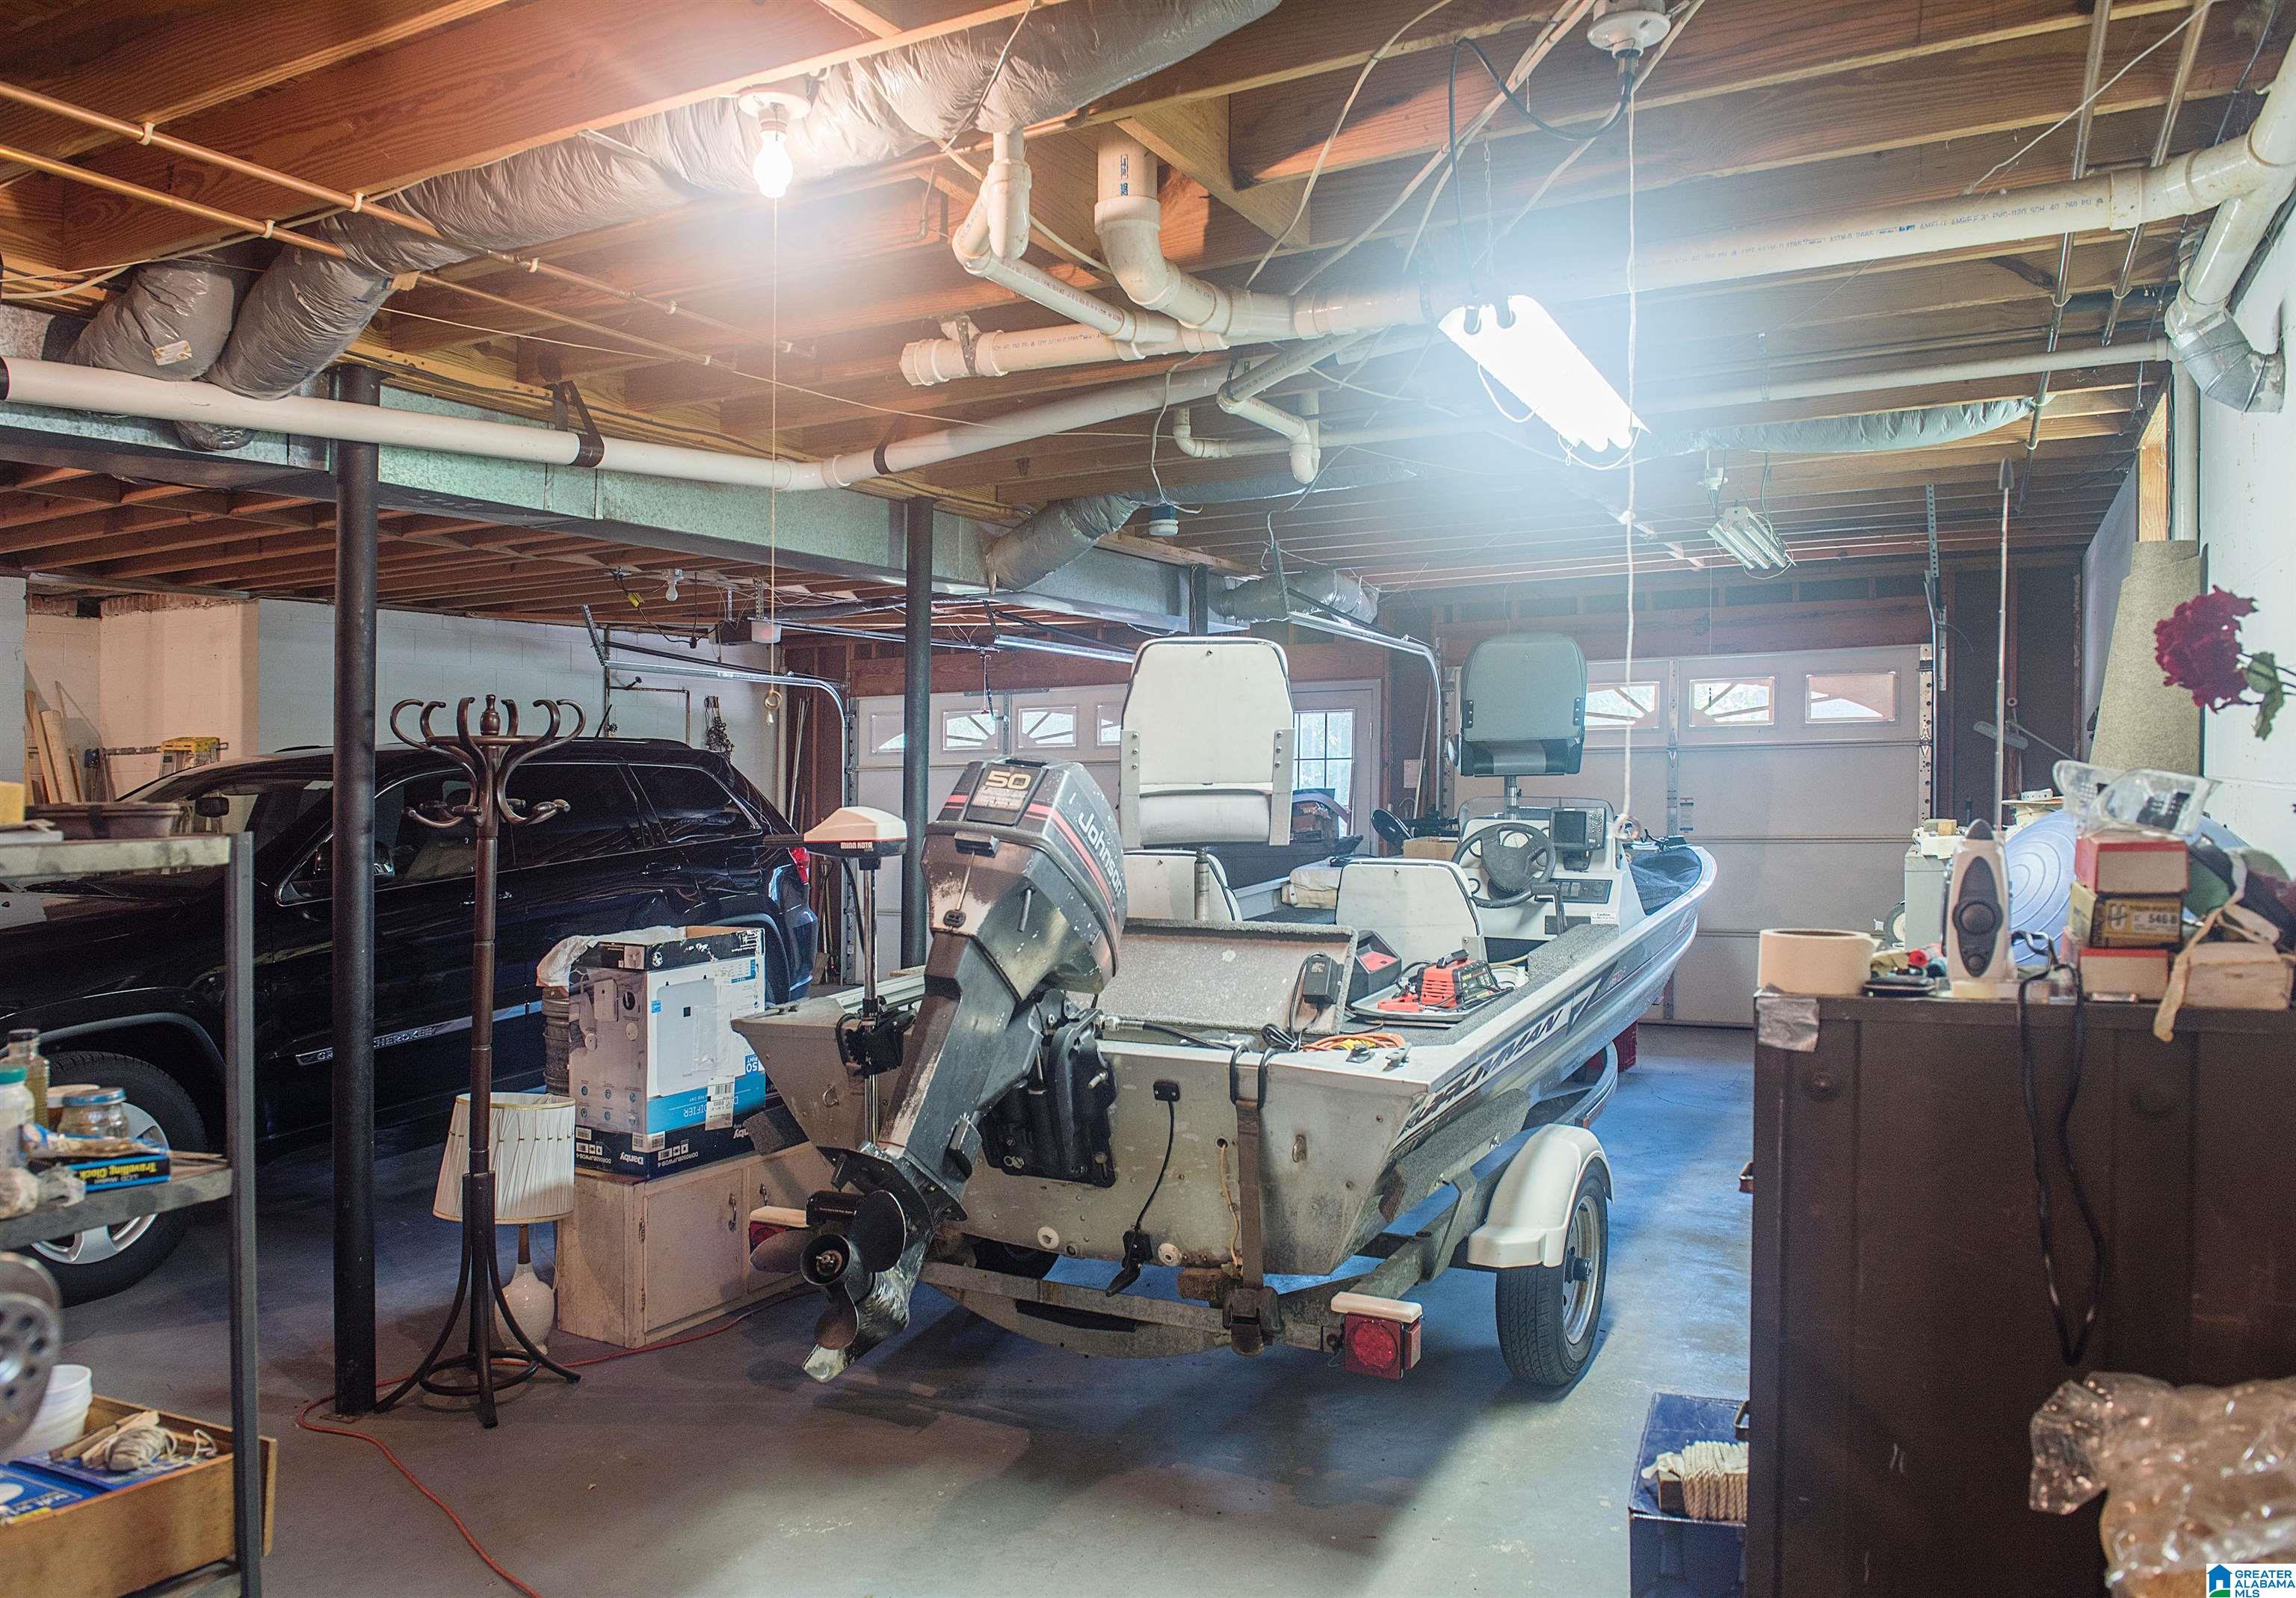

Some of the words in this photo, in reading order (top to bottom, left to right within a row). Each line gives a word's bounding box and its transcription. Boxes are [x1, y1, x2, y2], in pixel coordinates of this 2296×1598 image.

[985, 770, 1032, 791] 50
[1078, 811, 1123, 898] Johnson
[373, 1027, 433, 1049] HEROKEE
[746, 1061, 758, 1073] 50
[619, 1151, 644, 1165] Danby
